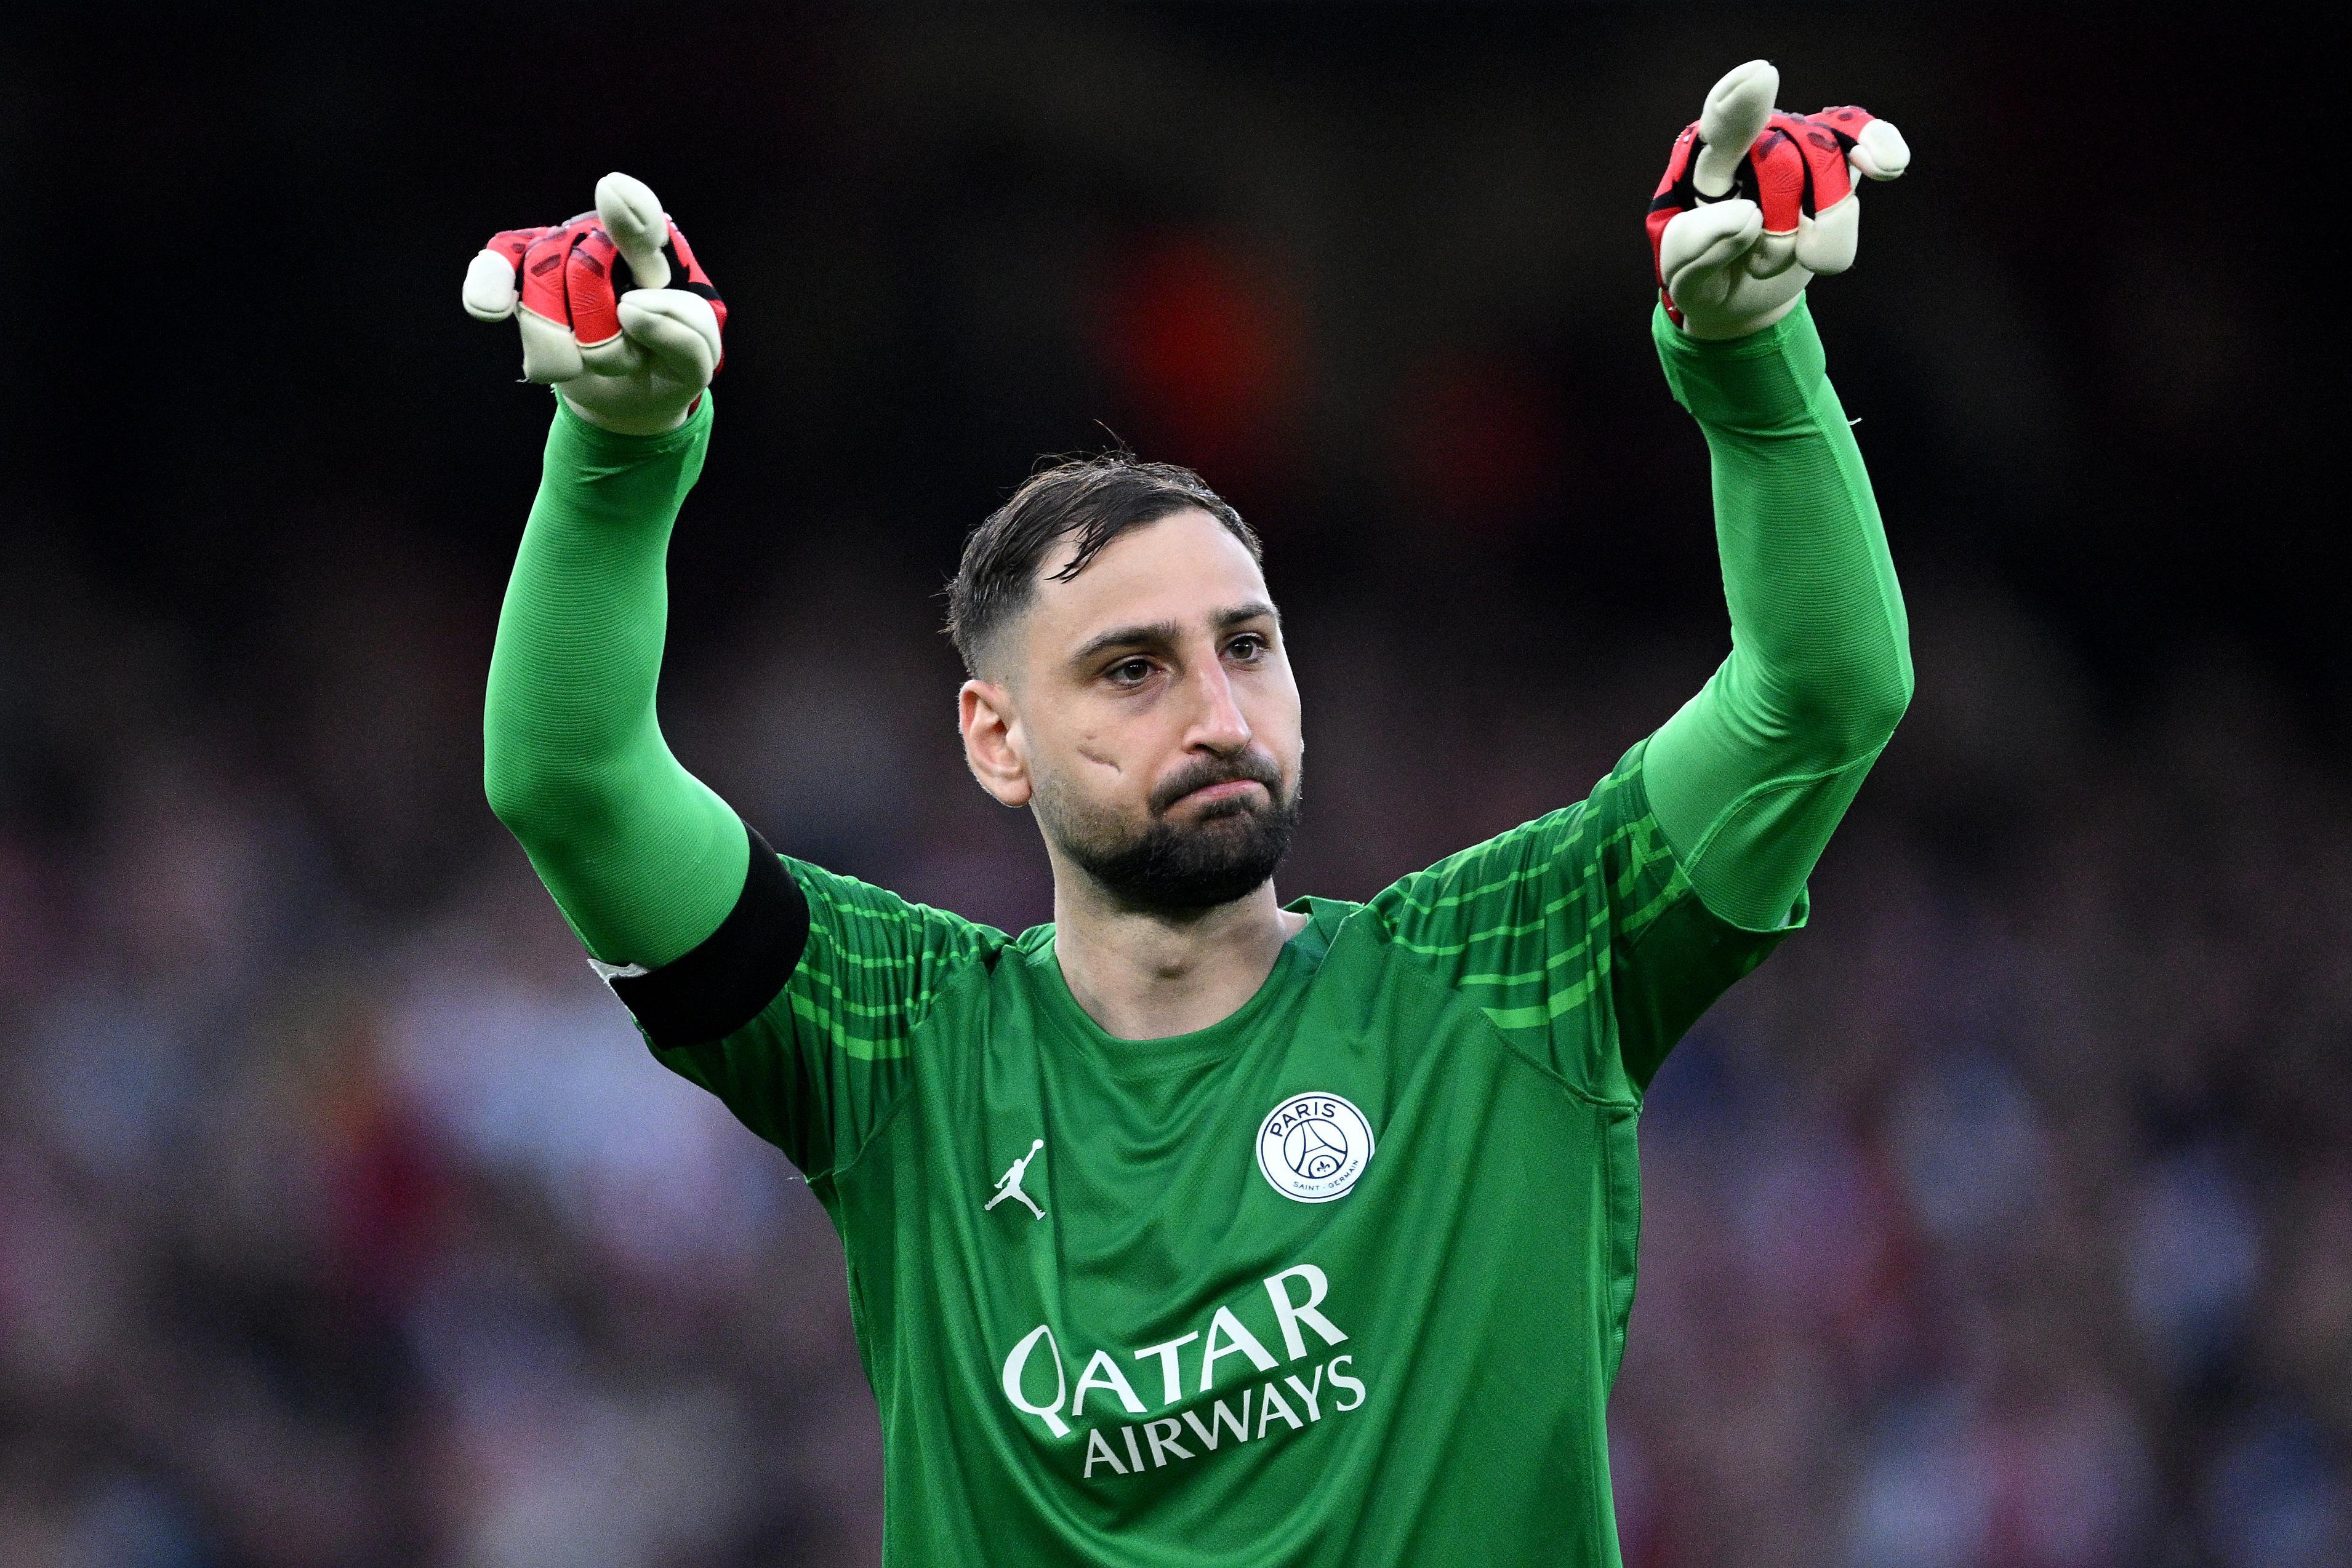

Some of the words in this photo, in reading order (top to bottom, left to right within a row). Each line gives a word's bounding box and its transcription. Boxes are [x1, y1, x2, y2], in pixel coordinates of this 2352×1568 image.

[1270, 1102, 1336, 1137] PARIS
[1002, 1263, 1349, 1438] QATAR
[1083, 1355, 1366, 1478] AIRWAYS
